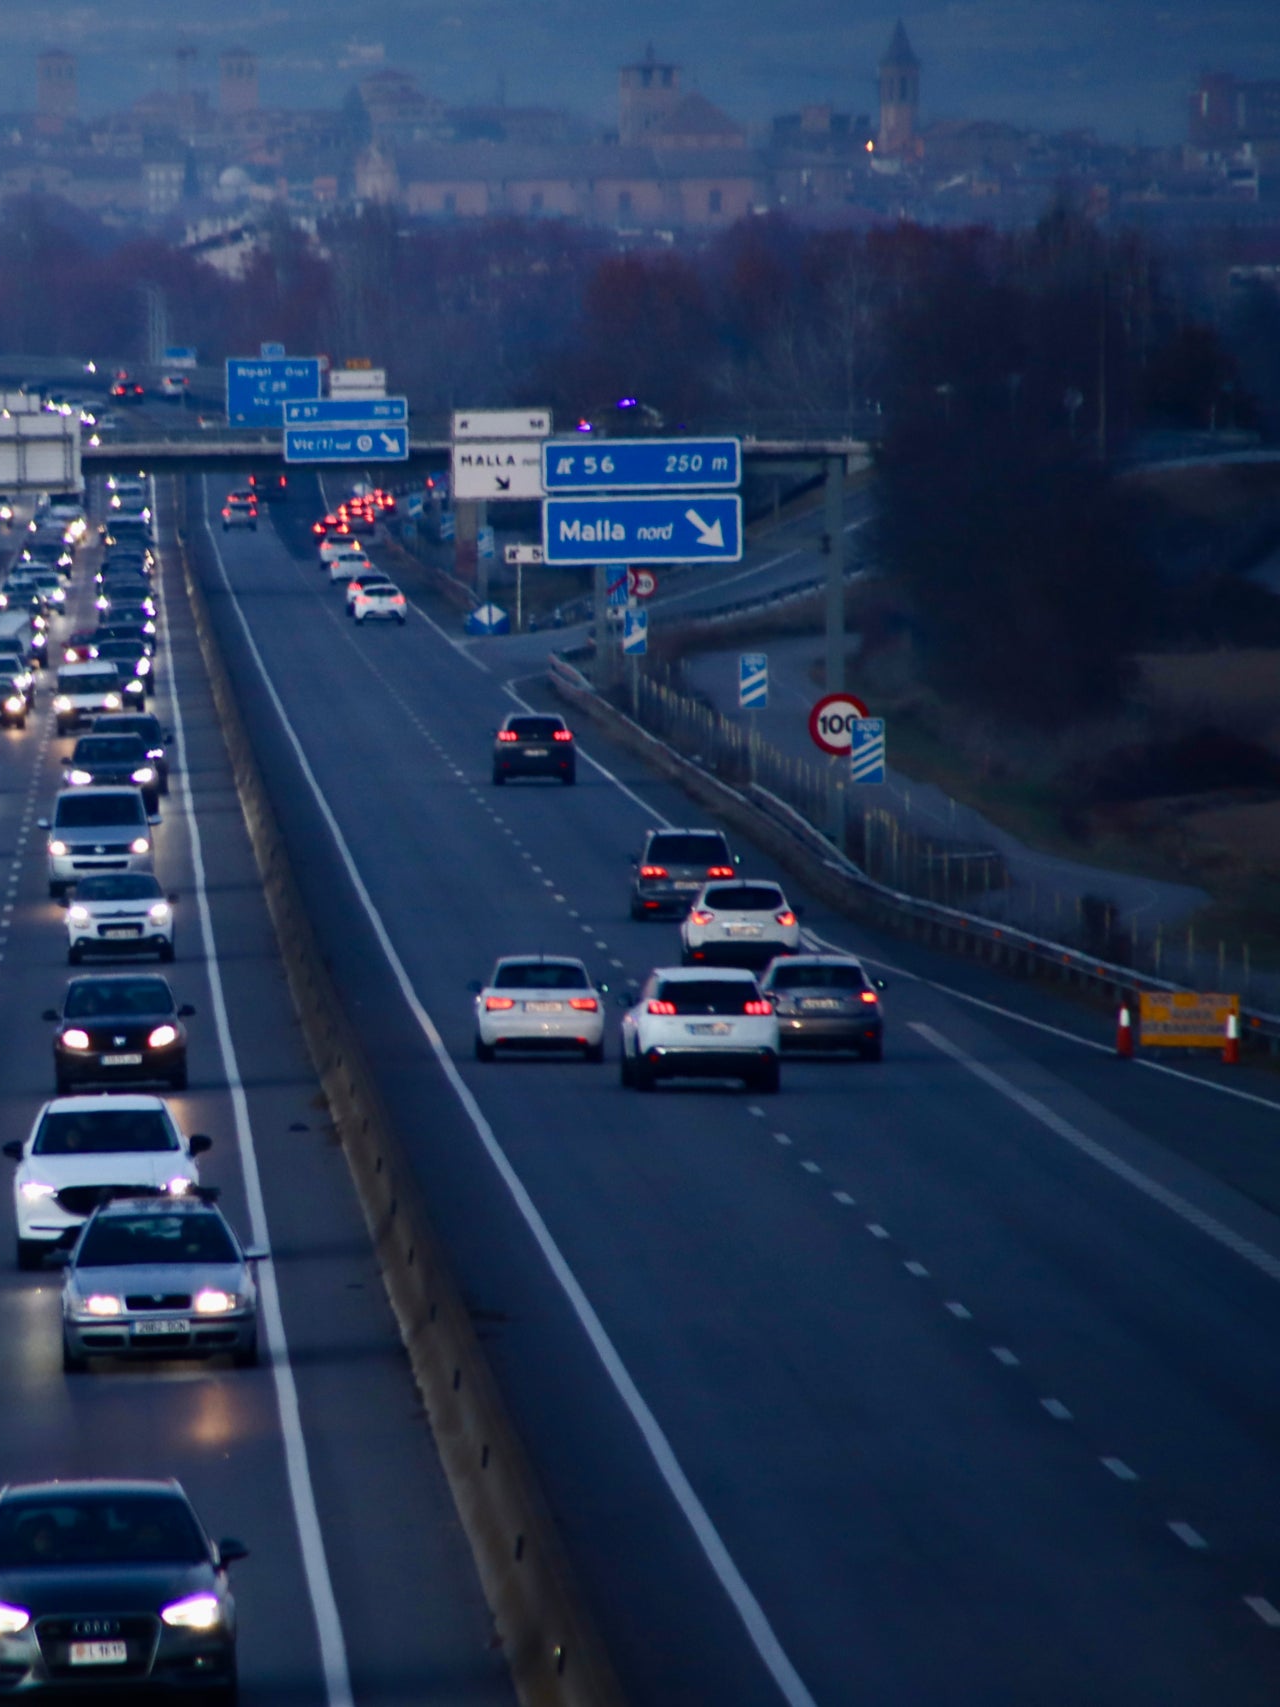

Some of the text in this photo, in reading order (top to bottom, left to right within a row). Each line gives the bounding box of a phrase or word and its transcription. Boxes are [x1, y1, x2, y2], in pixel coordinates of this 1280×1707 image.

[461, 455, 516, 466] MALLA
[583, 454, 728, 475] 56 250 m
[559, 519, 673, 542] Malla nord
